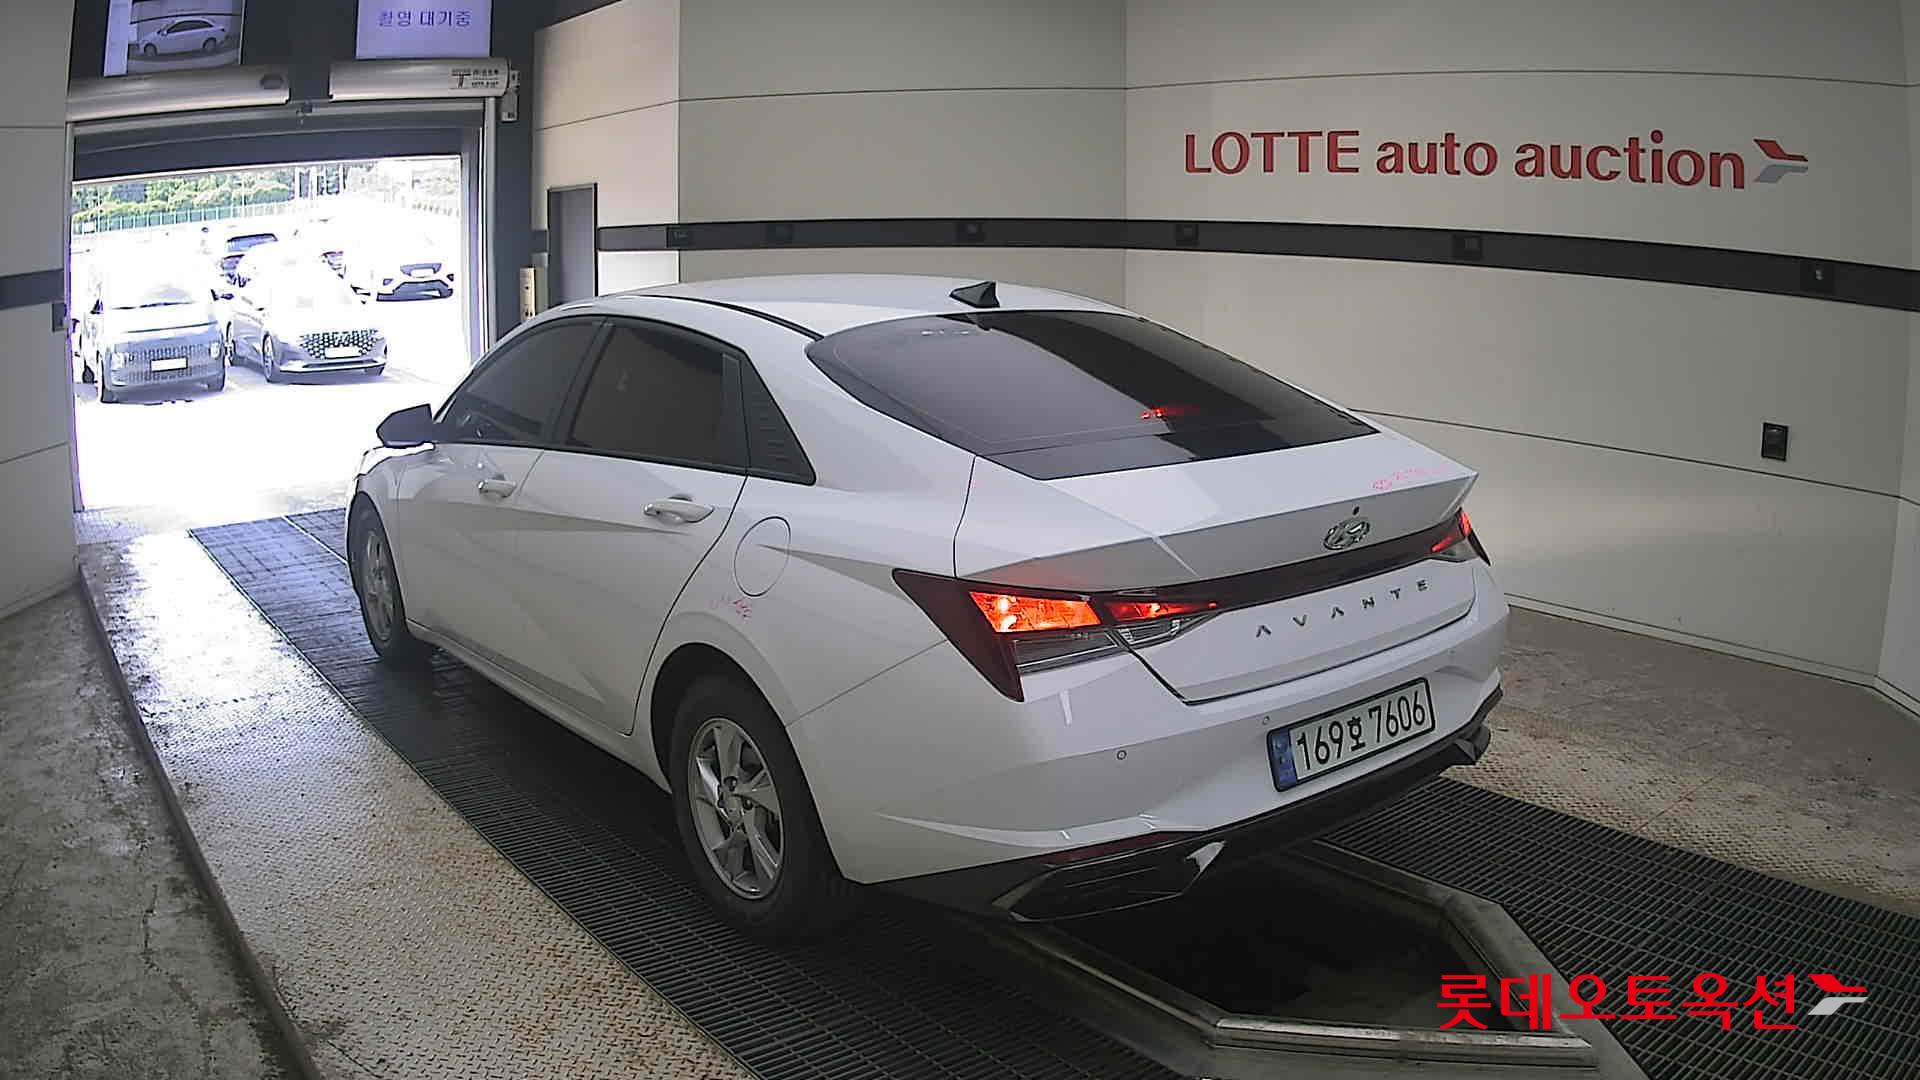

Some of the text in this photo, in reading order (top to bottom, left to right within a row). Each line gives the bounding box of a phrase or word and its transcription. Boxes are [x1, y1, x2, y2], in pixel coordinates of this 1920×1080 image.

[419, 9, 473, 28] 대기중
[1185, 130, 1745, 190] LOTTE auto auction
[1255, 579, 1429, 638] AVANTE
[1296, 716, 1366, 771] 169호
[1368, 690, 1426, 744] 7606
